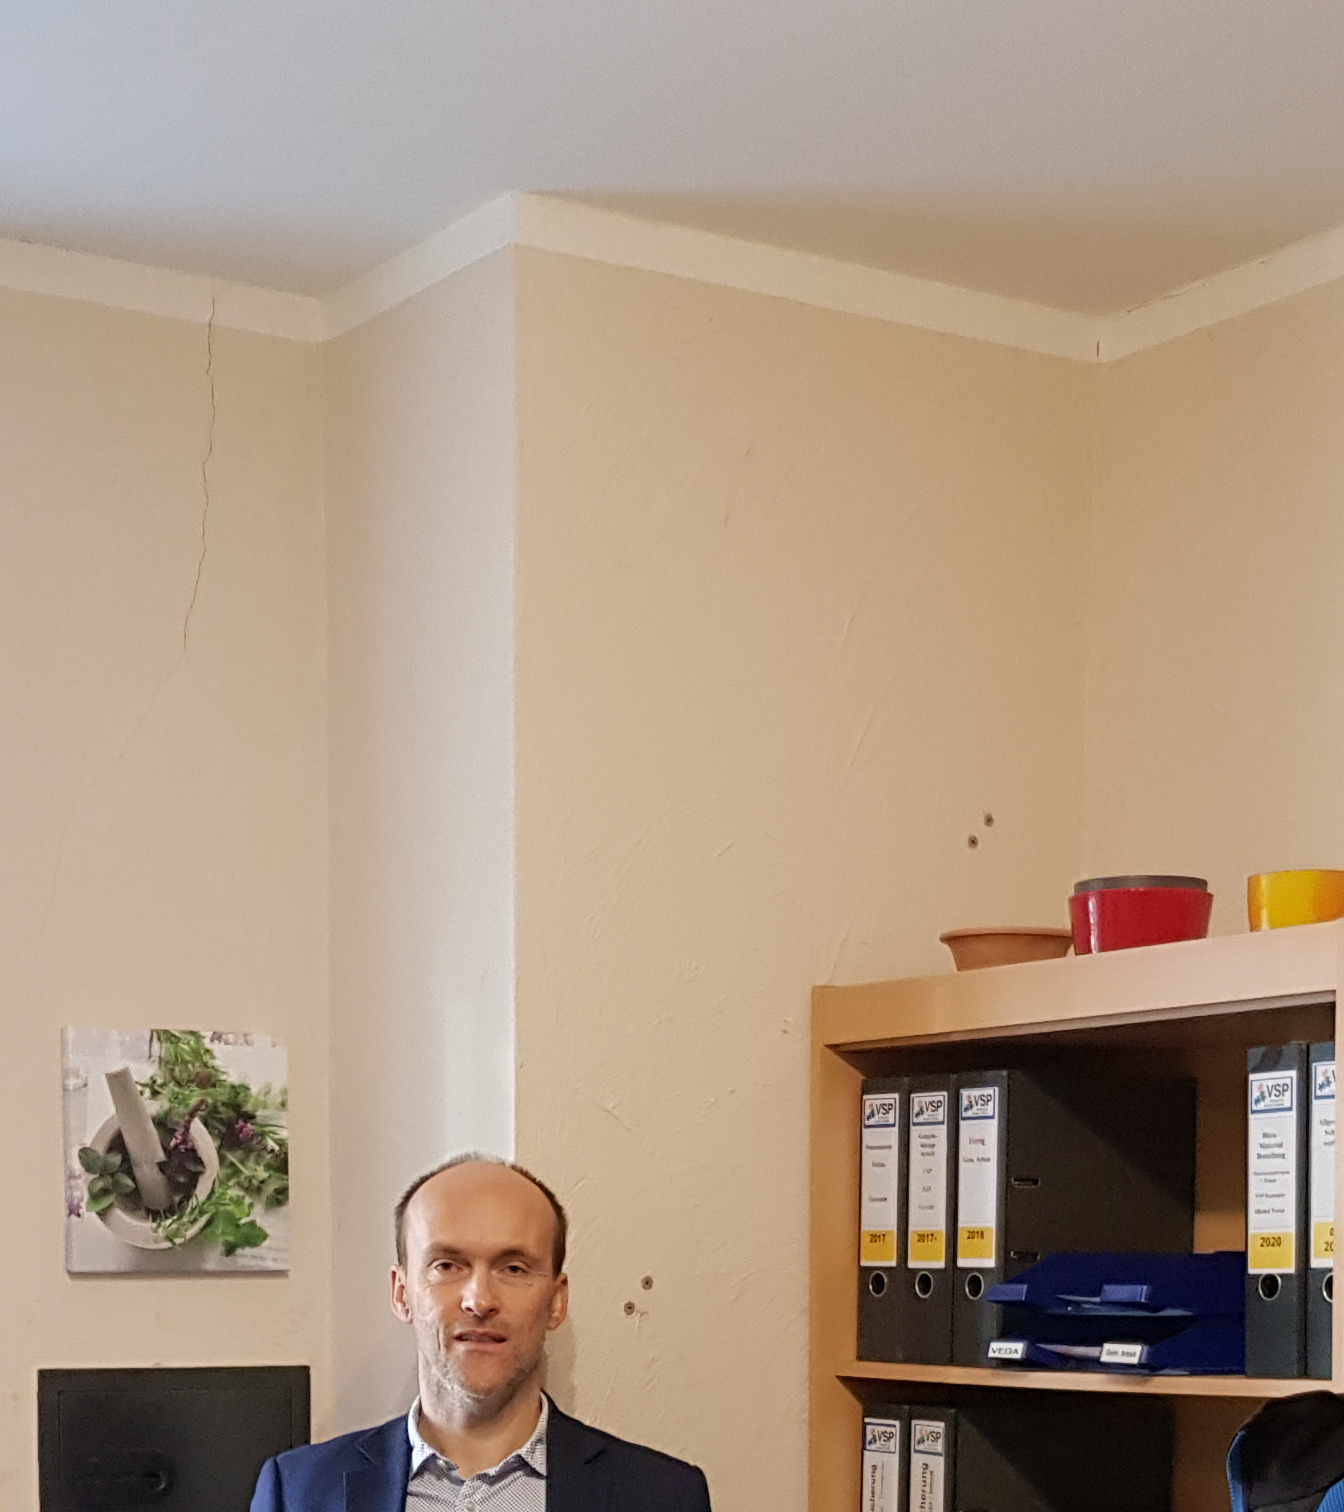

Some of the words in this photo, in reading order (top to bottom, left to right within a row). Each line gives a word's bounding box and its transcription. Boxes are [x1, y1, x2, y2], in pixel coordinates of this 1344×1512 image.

[1266, 1083, 1289, 1099] VSP
[924, 1100, 943, 1113] VSP
[974, 1094, 993, 1107] VSP
[875, 1103, 894, 1116] VSP
[868, 1233, 886, 1243] 2017
[966, 1230, 985, 1240] 2018
[1260, 1236, 1282, 1248] 2020
[877, 1429, 895, 1443] VSP
[926, 1430, 942, 1443] VSP
